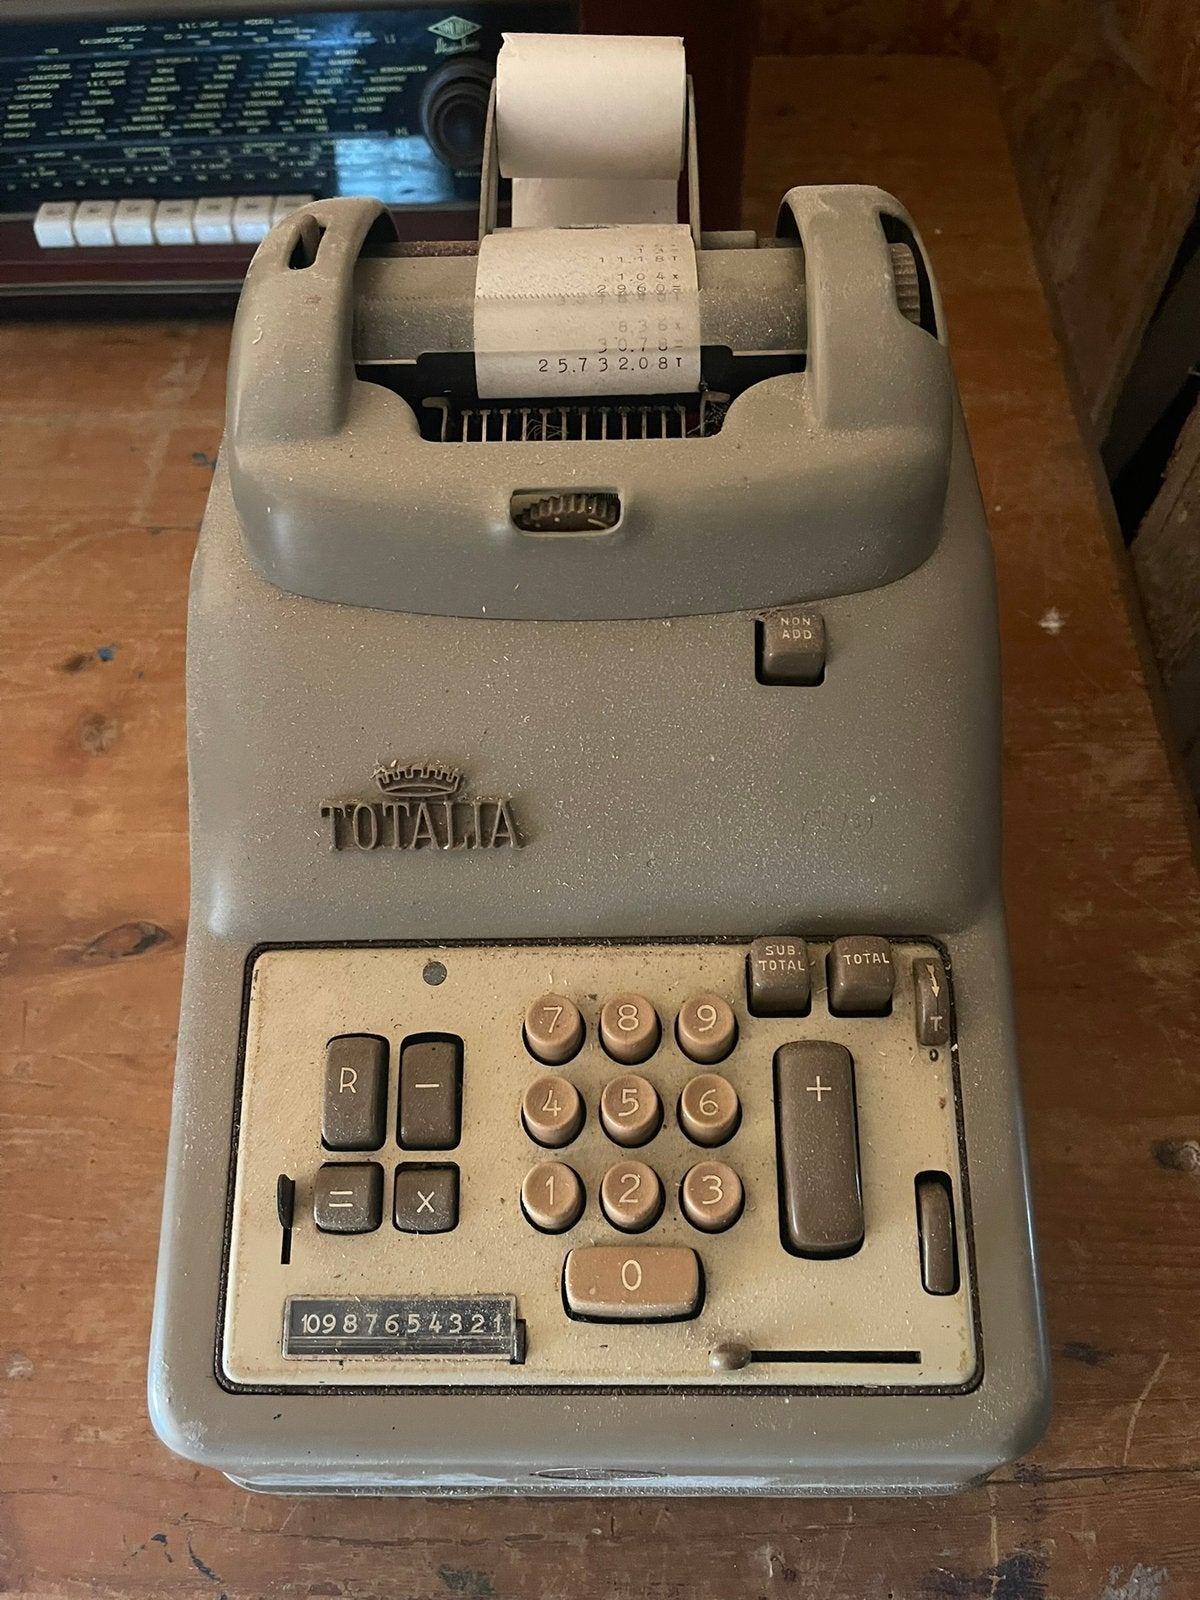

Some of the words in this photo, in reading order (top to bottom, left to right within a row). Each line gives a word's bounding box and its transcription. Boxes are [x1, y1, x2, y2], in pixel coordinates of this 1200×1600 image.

[781, 617, 811, 626] NON
[782, 629, 812, 639] ADD
[320, 799, 525, 851] TOTALIA
[758, 959, 806, 972] TOTAL
[844, 952, 891, 965] TOTAL
[543, 1005, 563, 1034] 7
[617, 1004, 639, 1032] 8
[696, 1004, 717, 1032] 9
[338, 1066, 358, 1094] R
[541, 1089, 562, 1117] 4
[618, 1088, 640, 1117] 5
[699, 1088, 719, 1116] 6
[545, 1175, 555, 1206] 1
[618, 1173, 641, 1204] 2
[701, 1174, 724, 1205] 3
[621, 1259, 643, 1291] 0
